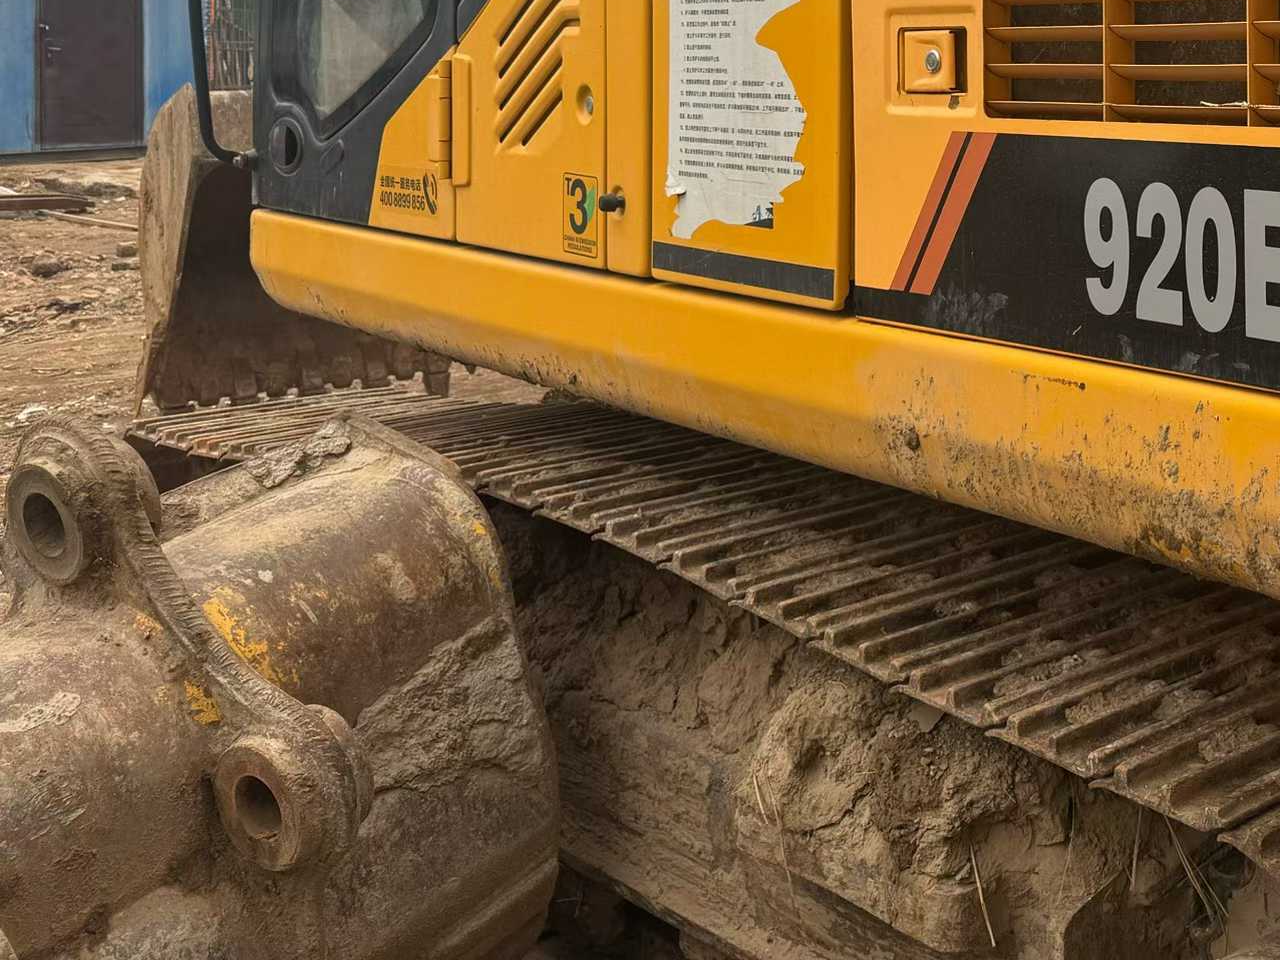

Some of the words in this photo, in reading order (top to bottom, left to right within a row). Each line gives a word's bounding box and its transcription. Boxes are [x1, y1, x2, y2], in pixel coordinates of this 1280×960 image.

[380, 175, 421, 191] 全国统一服务电话
